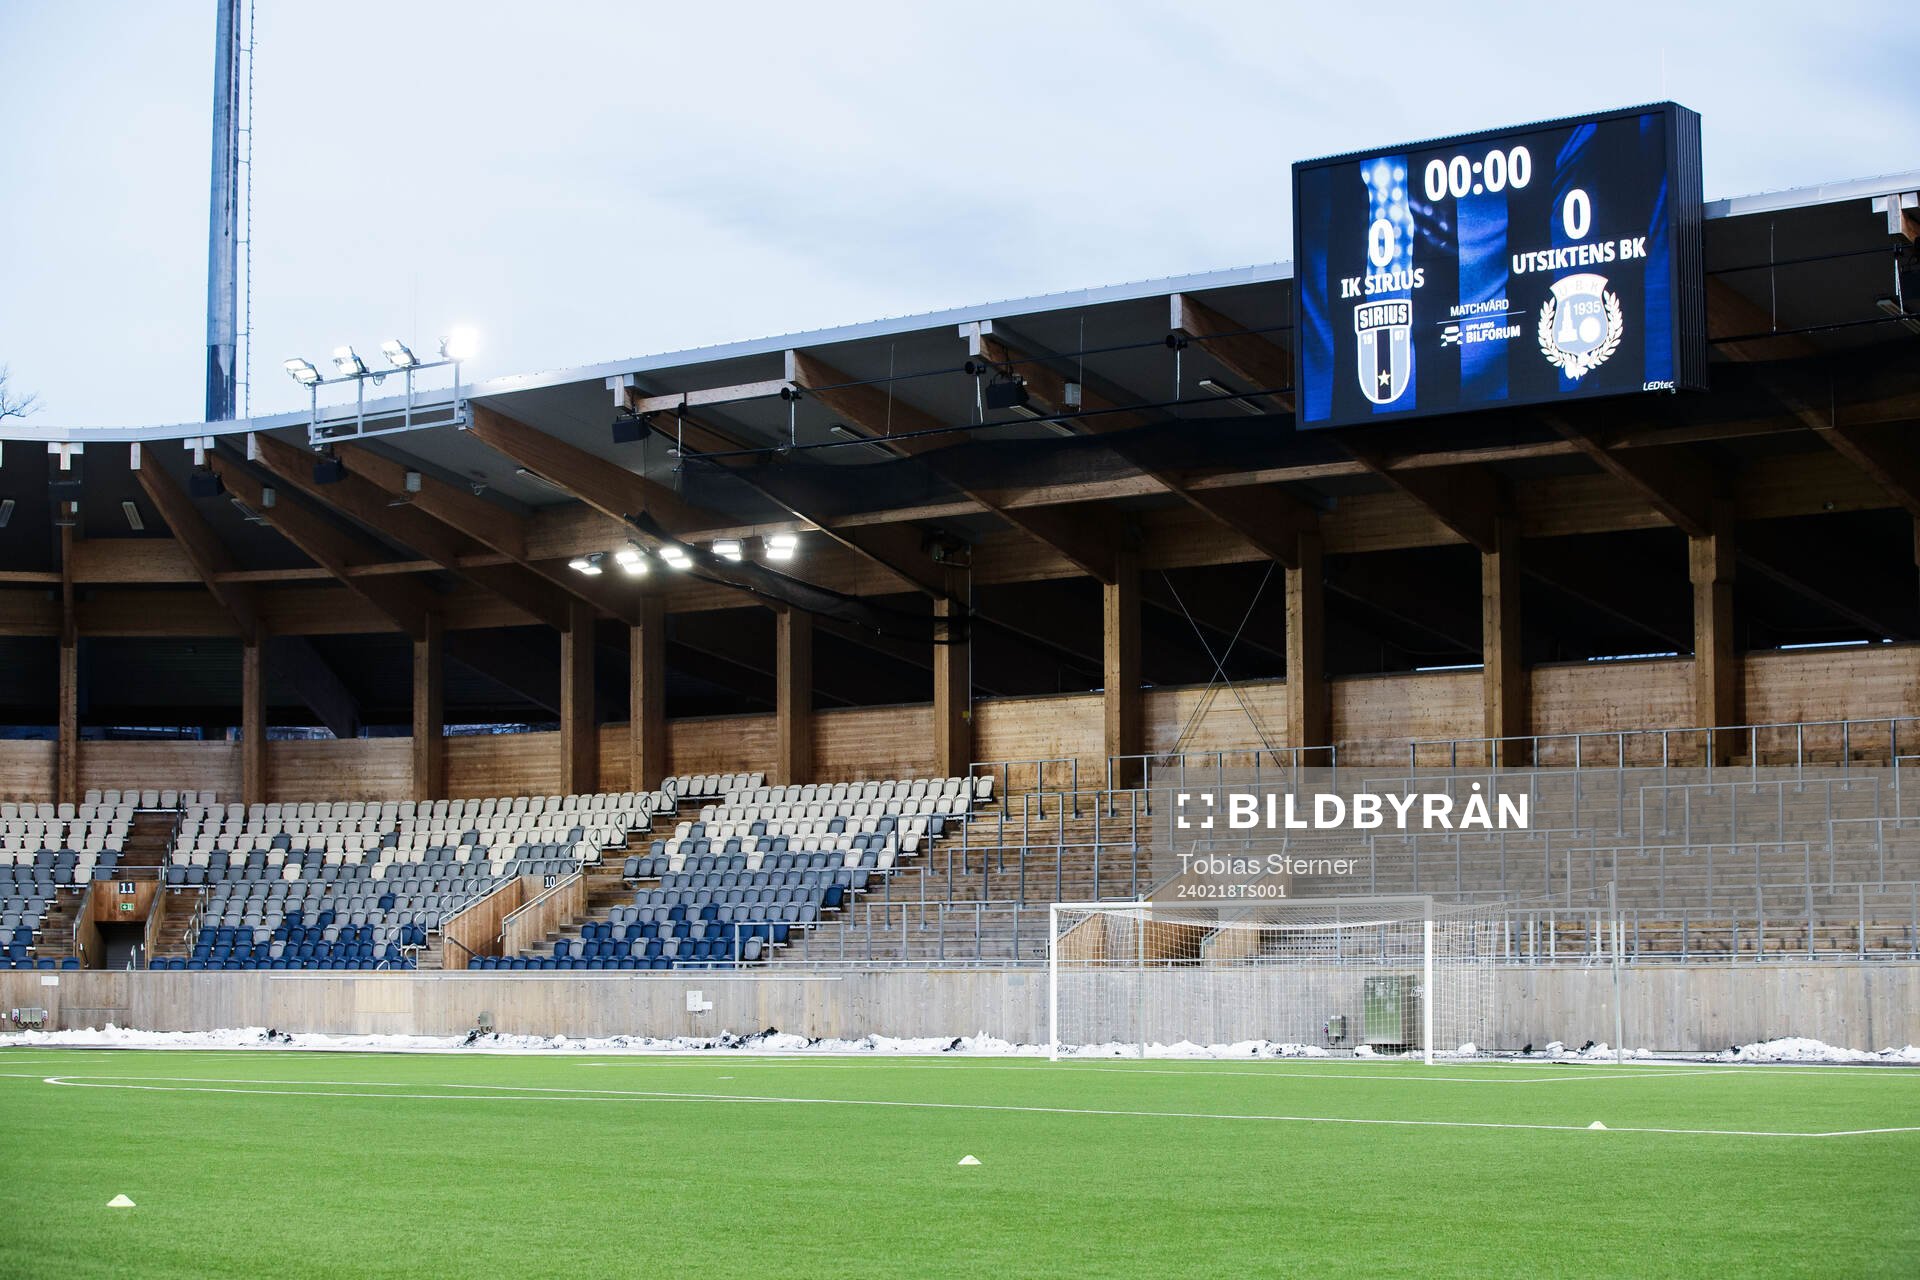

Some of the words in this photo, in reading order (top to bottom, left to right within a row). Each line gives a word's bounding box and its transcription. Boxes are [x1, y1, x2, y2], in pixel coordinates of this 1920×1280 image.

[1424, 146, 1531, 201] 00:00
[1562, 188, 1591, 240] 0
[1368, 218, 1395, 267] 0
[1512, 241, 1616, 275] UTSIKTENS
[1619, 236, 1647, 260] BK
[1340, 277, 1362, 299] IK
[1364, 267, 1425, 295] SIRIUS
[1359, 304, 1408, 329] SIRIUS
[1573, 301, 1601, 316] 1935
[1465, 324, 1521, 344] BILFORUM
[1643, 380, 1675, 391] LEDtec
[120, 882, 135, 894] 11
[544, 876, 556, 887] 10
